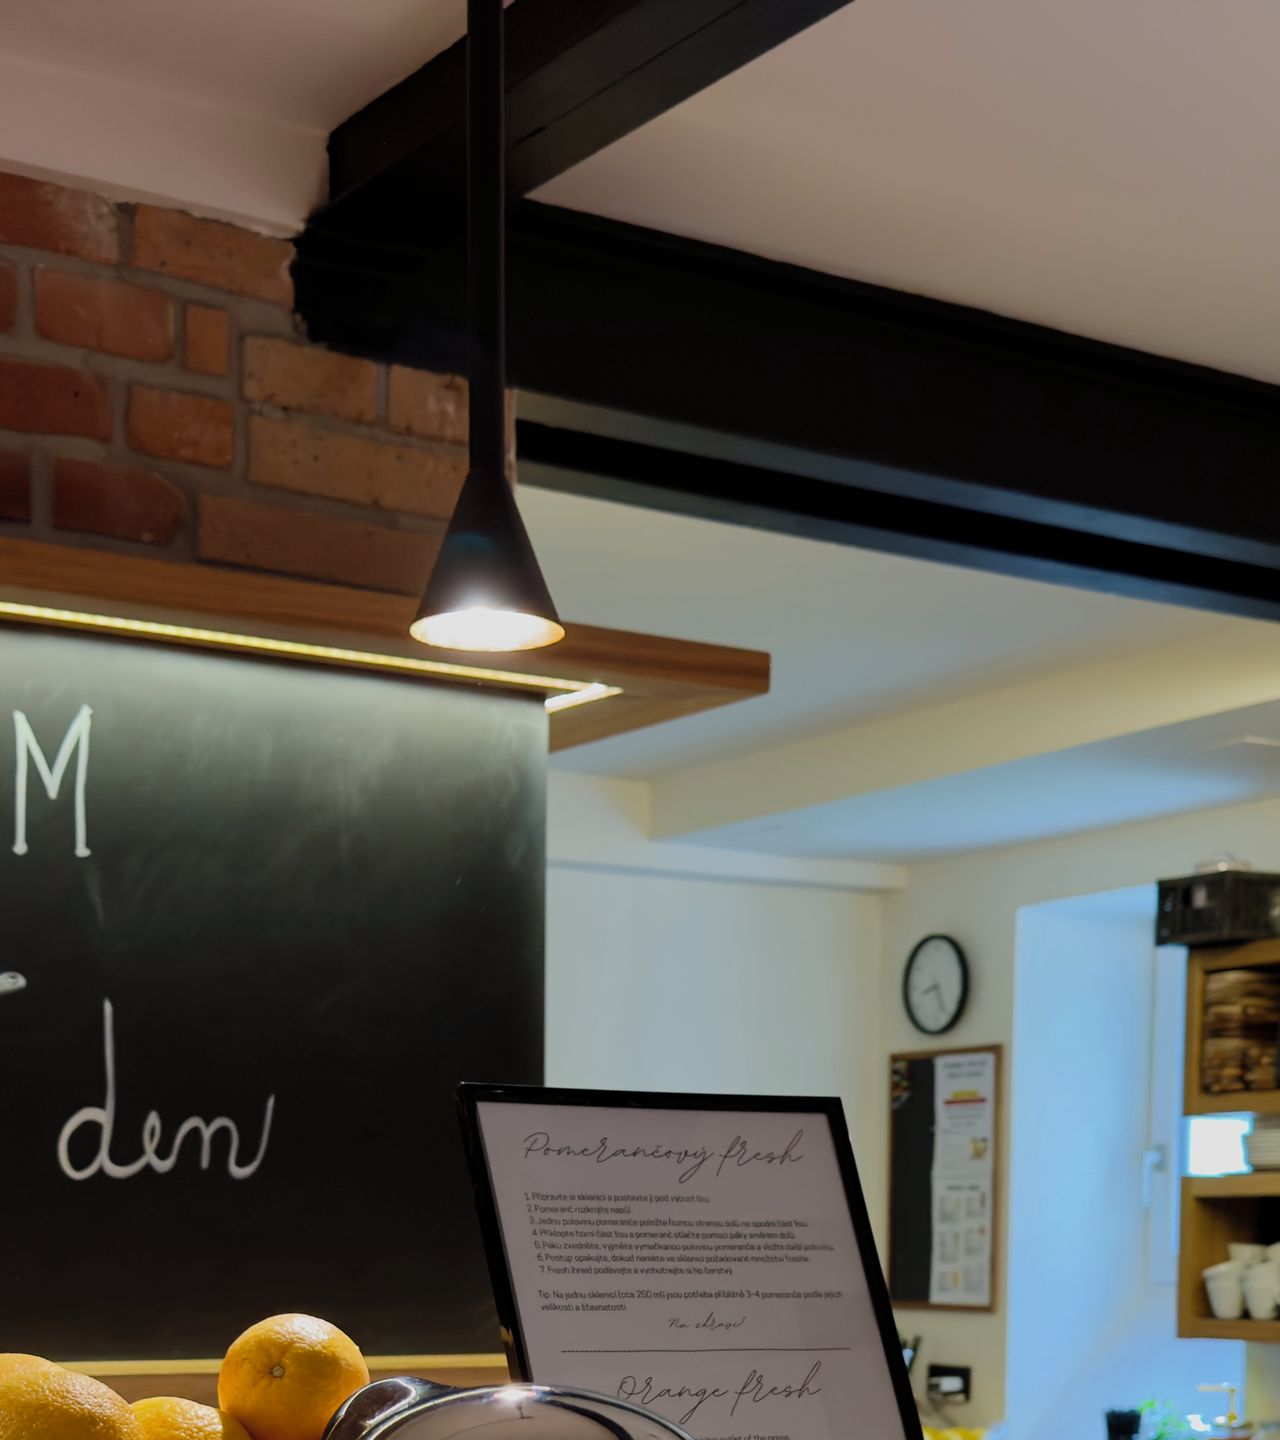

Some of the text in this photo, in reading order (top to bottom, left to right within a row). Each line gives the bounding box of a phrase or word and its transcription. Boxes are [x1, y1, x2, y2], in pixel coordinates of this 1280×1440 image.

[56, 998, 276, 1181] den
[522, 1129, 804, 1184] Pomerančový fresh
[729, 1360, 822, 1416] fresh
